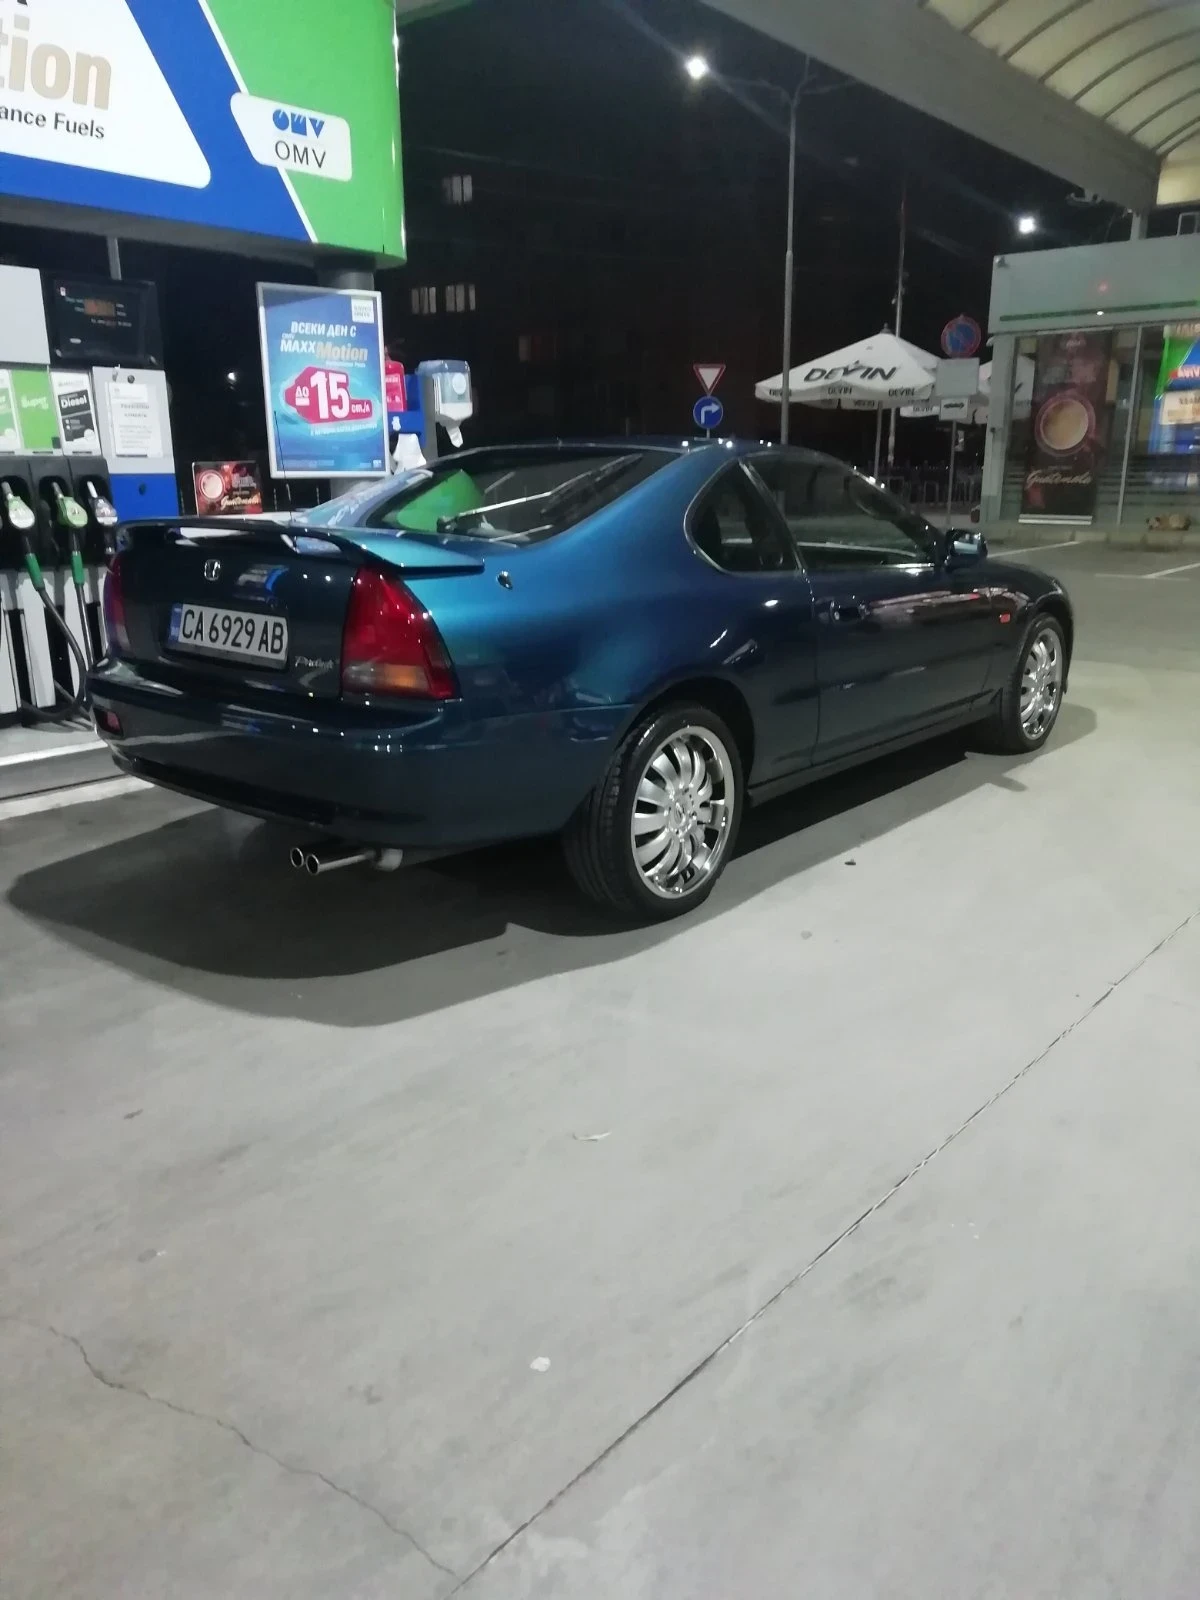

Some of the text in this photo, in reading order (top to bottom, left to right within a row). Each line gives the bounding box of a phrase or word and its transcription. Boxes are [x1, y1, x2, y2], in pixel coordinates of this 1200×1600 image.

[53, 112, 105, 140] Fuels
[274, 140, 327, 169] OMV
[291, 321, 325, 335] ВСЕКИ
[326, 323, 348, 338] ДЕН
[803, 360, 897, 382] DEVIN
[60, 394, 87, 409] Diesel
[310, 371, 350, 419] 15
[888, 387, 916, 397] DEVIN
